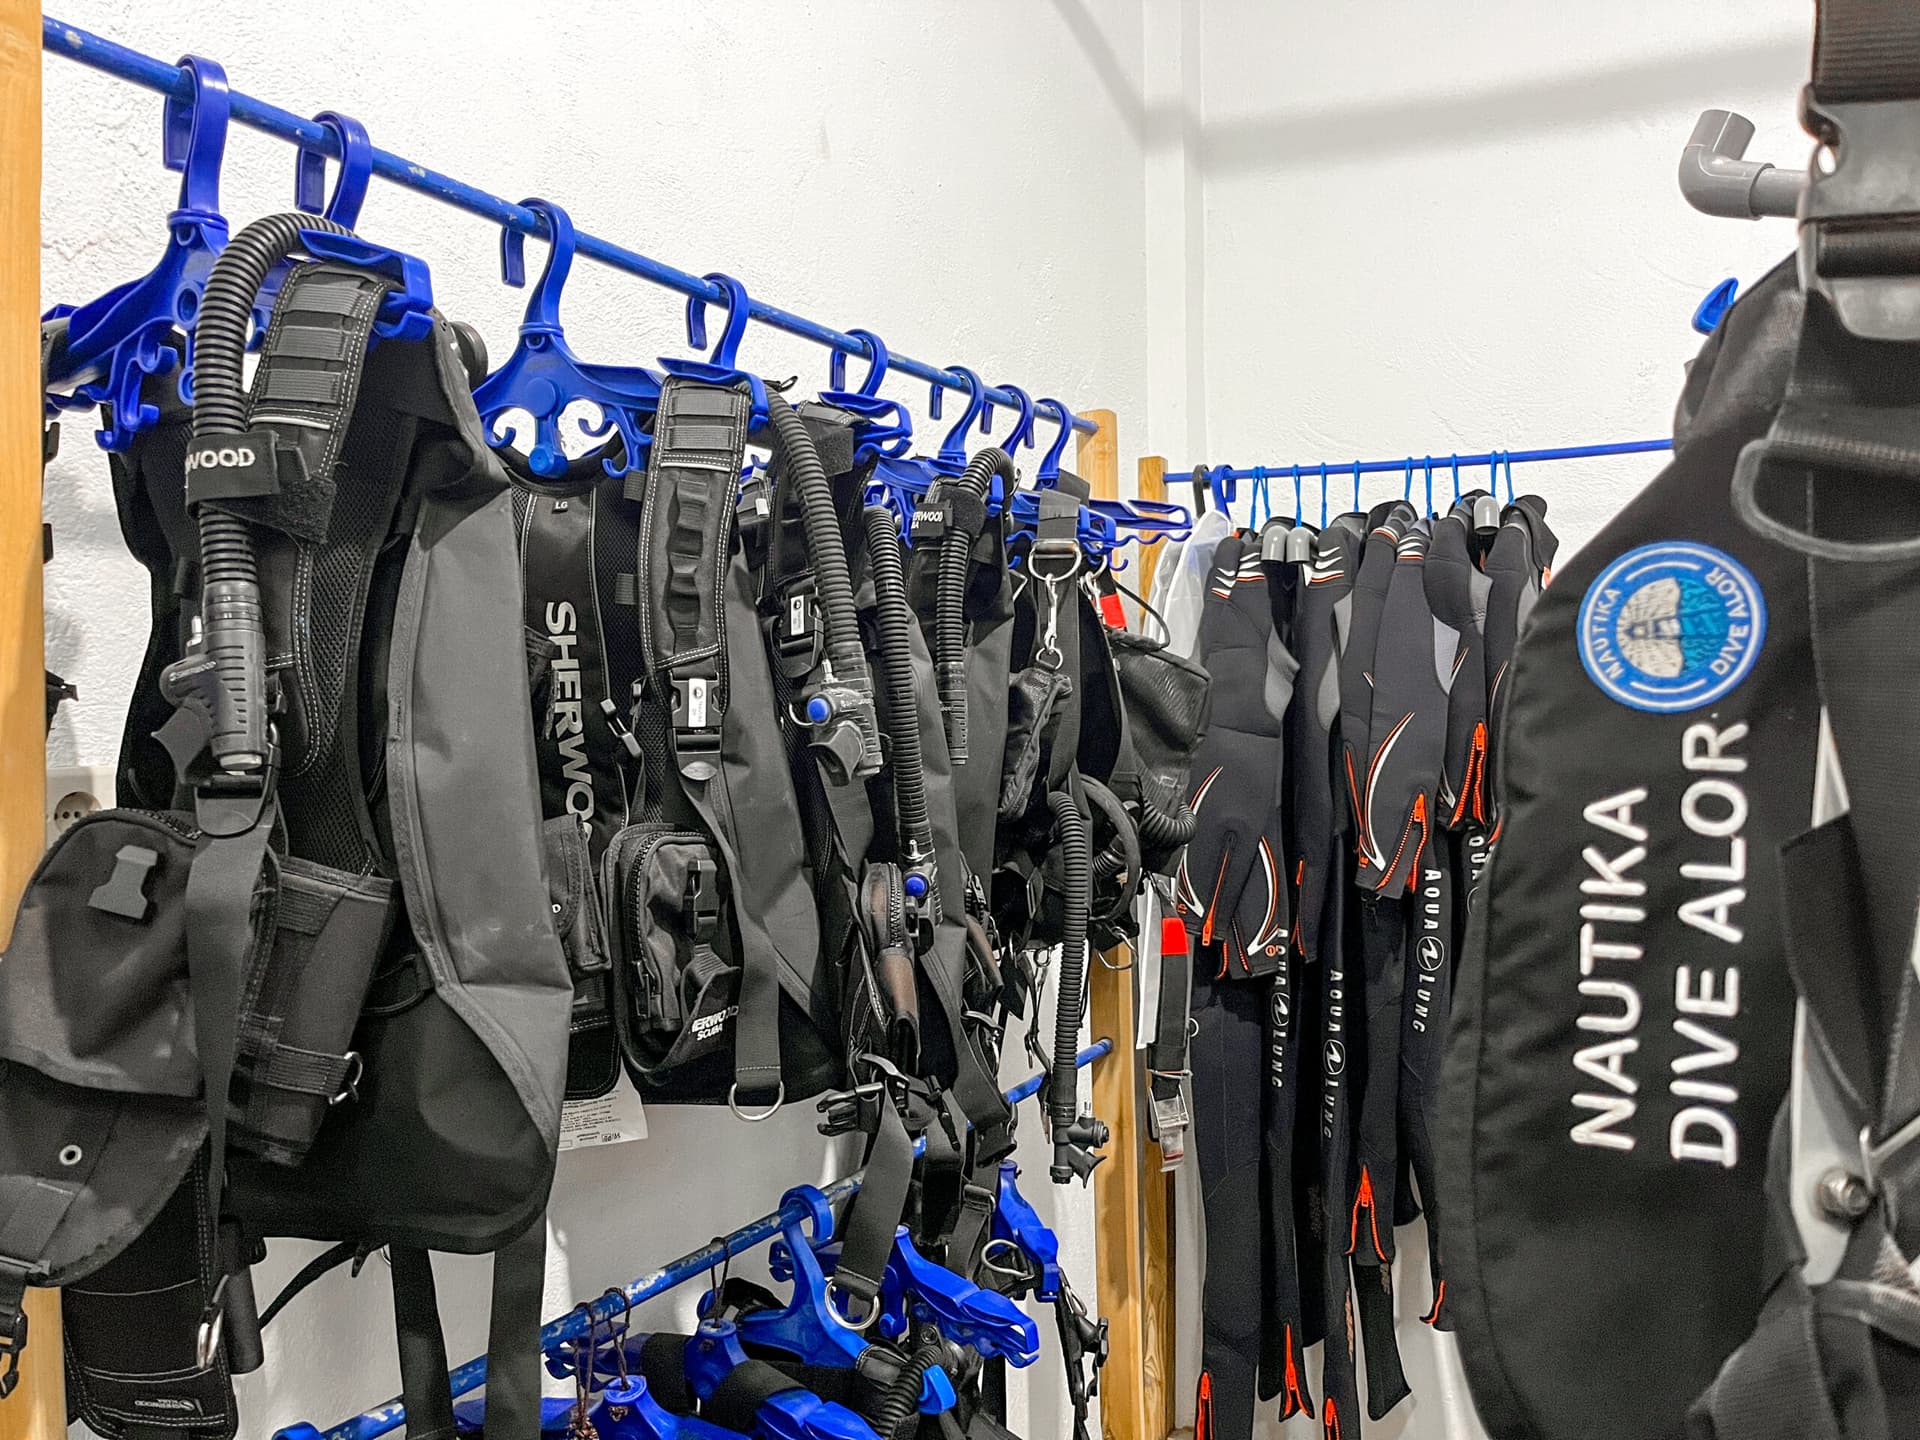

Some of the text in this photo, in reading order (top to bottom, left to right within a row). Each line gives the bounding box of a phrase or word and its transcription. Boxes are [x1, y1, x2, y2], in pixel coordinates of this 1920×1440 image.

[555, 501, 568, 509] LG
[1592, 589, 1622, 679] NAUTIKA
[1705, 567, 1749, 676] DIVE ALOR
[545, 601, 594, 842] SHERWO
[1412, 869, 1442, 1033] AQUA LUNG
[1571, 788, 1648, 1150] NAUTIKA
[1670, 723, 1749, 1168] DIVE ALOR
[1328, 969, 1343, 1032] AQUA
[1272, 1029, 1287, 1088] LUNG
